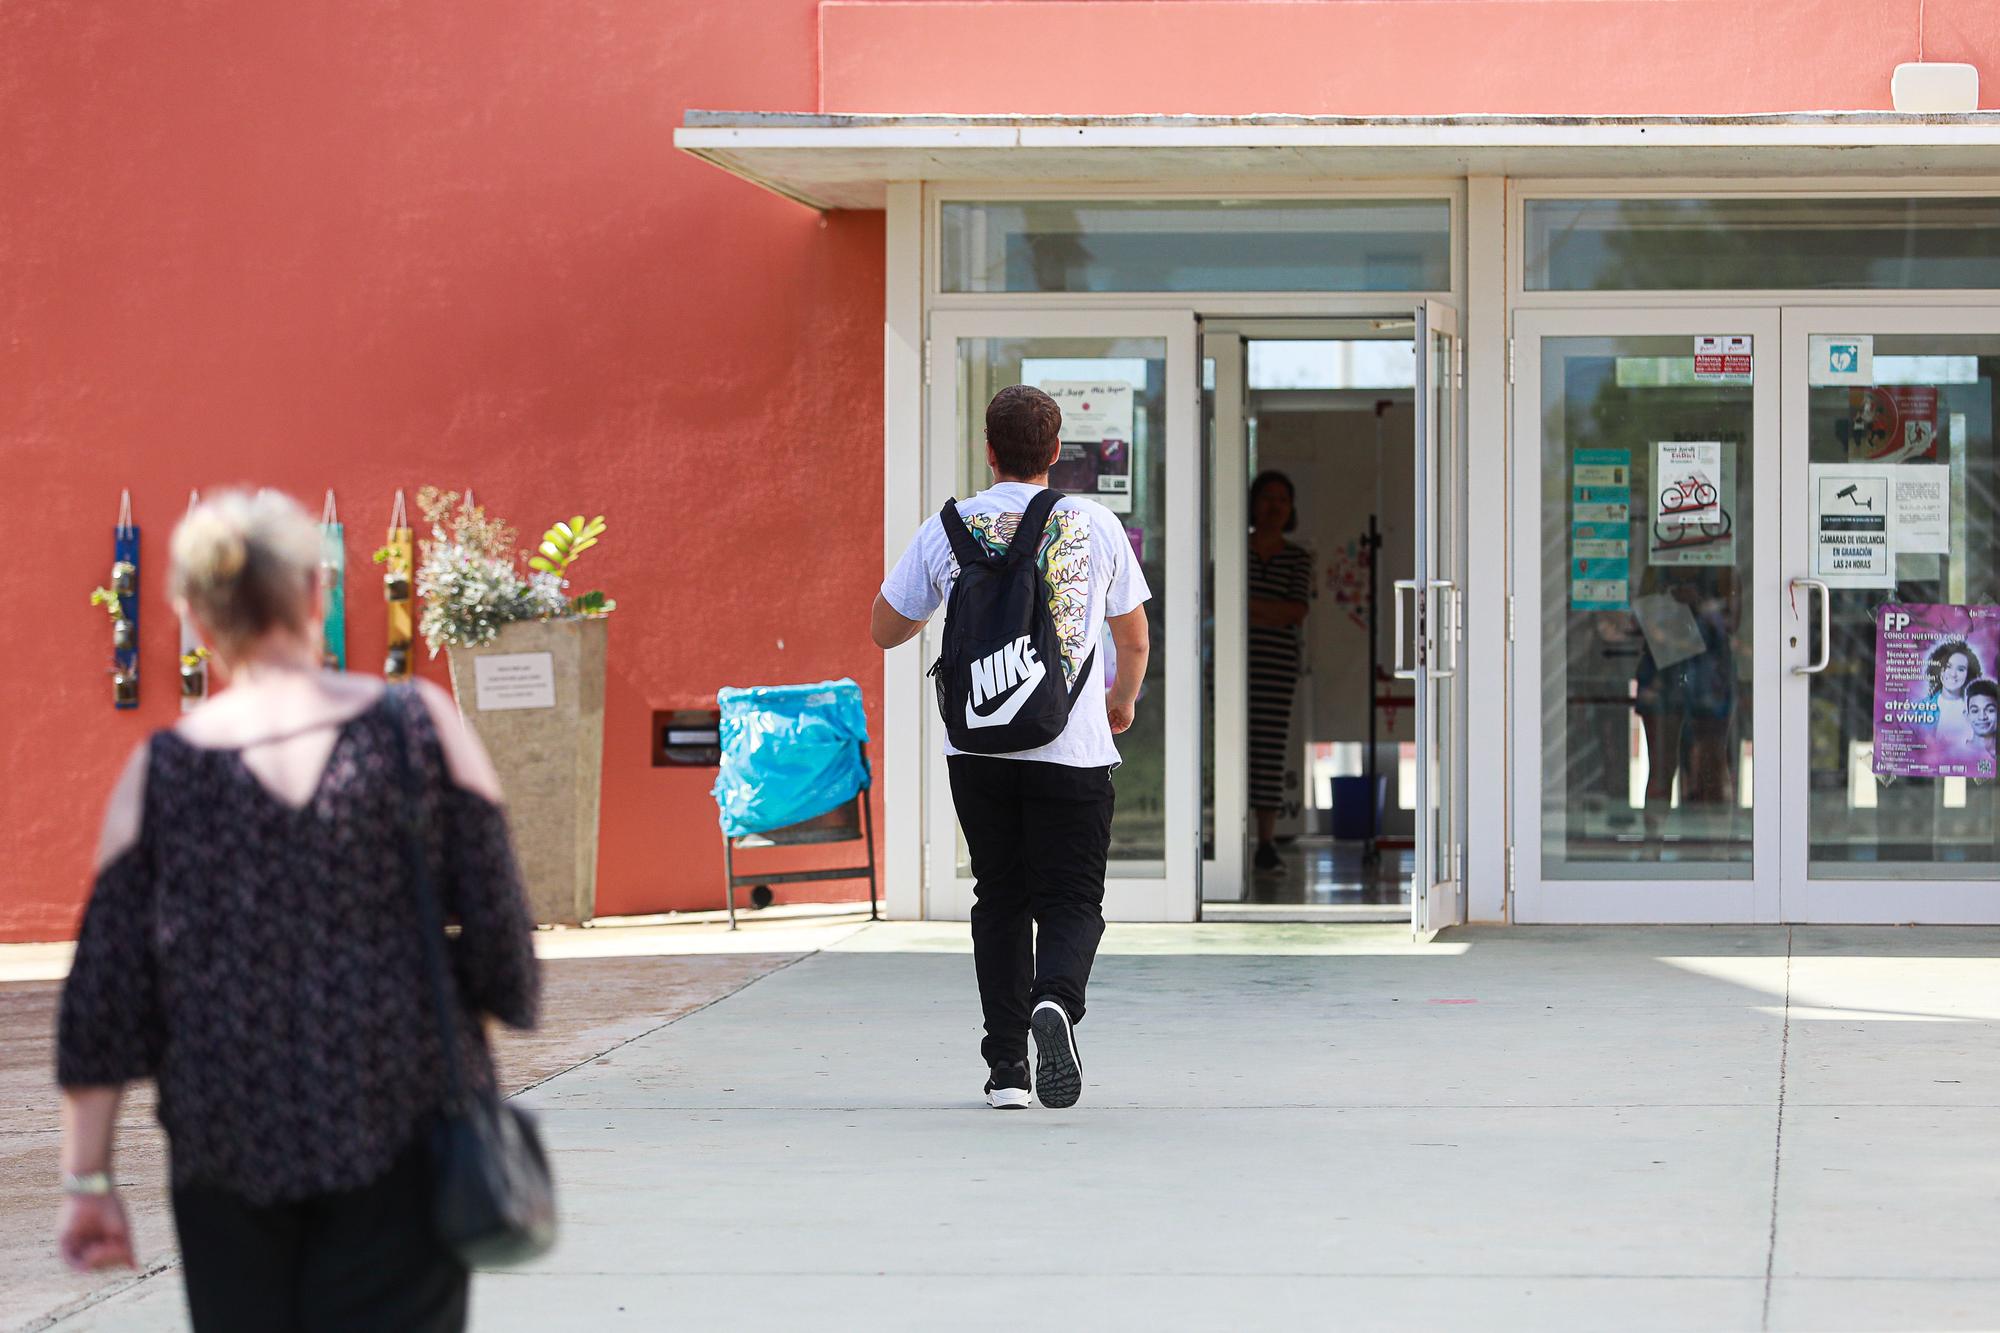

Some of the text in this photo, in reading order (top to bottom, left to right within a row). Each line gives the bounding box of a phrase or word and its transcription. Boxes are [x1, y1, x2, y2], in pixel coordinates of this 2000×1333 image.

[1820, 534, 1885, 544] CÁMARAS DE VIGILANCIA
[1832, 546, 1872, 556] EN GRABACIÓN
[1833, 560, 1871, 568] LAS 24 HORAS
[1884, 612, 1910, 632] FP
[1883, 632, 1909, 640] CONOCE
[1911, 632, 1942, 641] NUESTROS
[971, 634, 1041, 708] NIKE
[1891, 673, 1936, 681] rehabilitación
[1884, 699, 1937, 711] atrévete
[1884, 712, 1935, 723] a vivirlo
